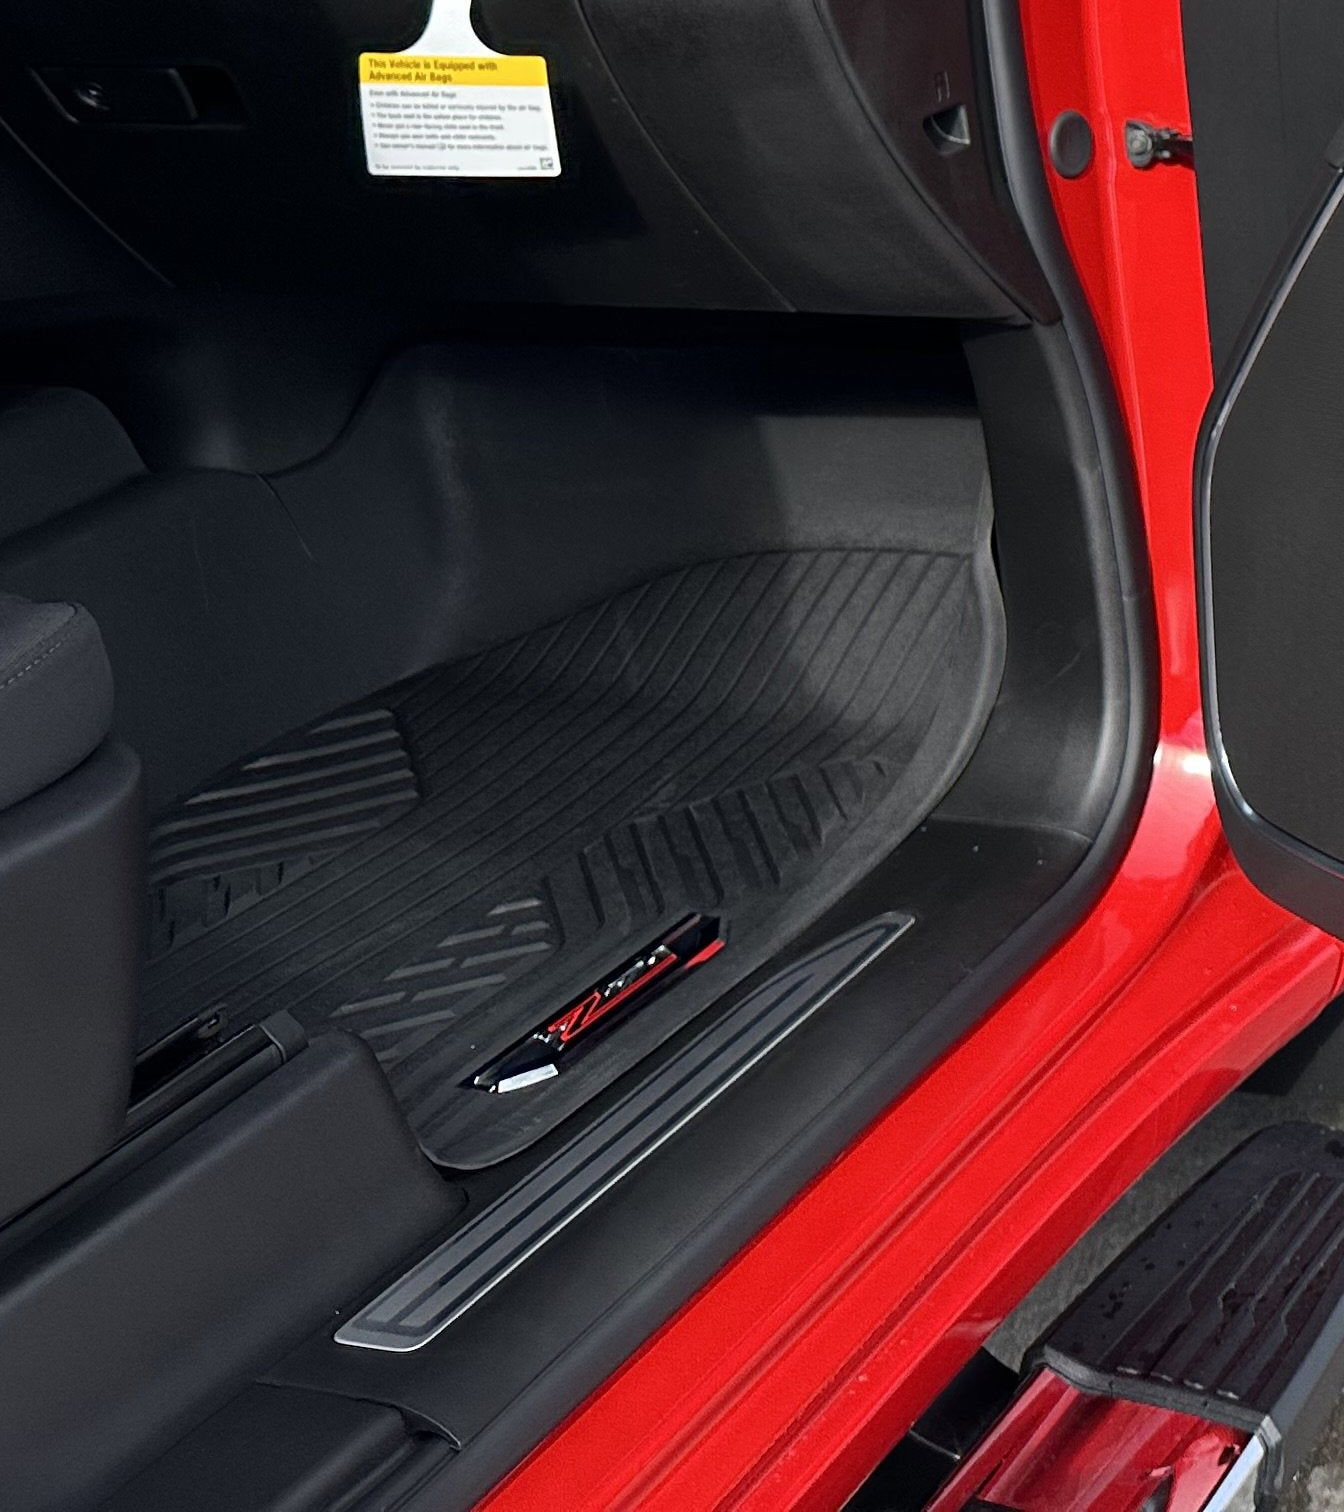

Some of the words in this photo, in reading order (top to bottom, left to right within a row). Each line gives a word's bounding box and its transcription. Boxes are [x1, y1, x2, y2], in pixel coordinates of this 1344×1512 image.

[368, 58, 386, 69] This
[389, 59, 421, 69] Vehicle
[424, 59, 431, 69] is
[433, 59, 475, 71] Equipped
[478, 61, 498, 70] with
[369, 70, 412, 81] Advanced
[415, 71, 427, 81] Air
[430, 72, 452, 84] Bags
